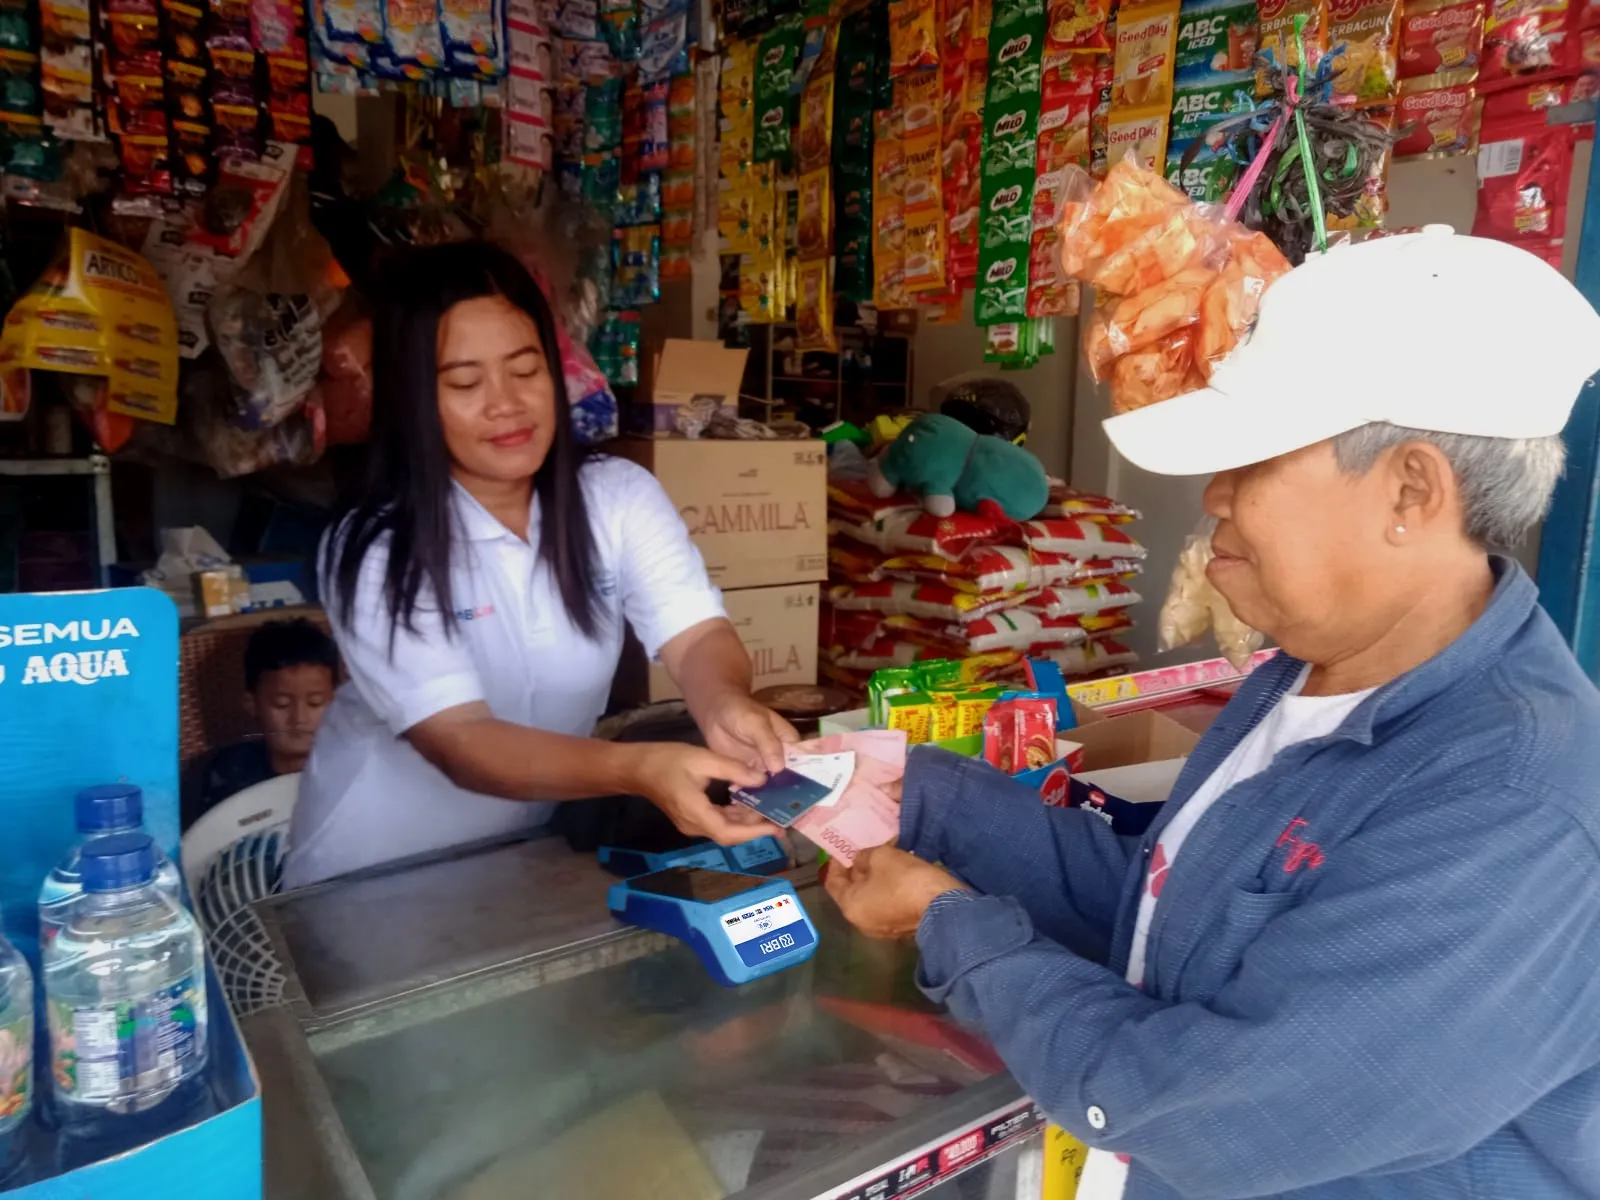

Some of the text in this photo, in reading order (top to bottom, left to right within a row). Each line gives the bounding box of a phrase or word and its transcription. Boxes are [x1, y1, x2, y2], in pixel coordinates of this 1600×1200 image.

[1179, 16, 1226, 40] ABC
[1001, 41, 1027, 59] MILO
[1187, 37, 1216, 50] ICED
[1172, 91, 1222, 115] ABC
[996, 116, 1023, 132] MILO
[1109, 128, 1138, 144] Good
[1139, 126, 1158, 142] Day
[1168, 167, 1213, 187] ABC
[994, 192, 1018, 207] MILO
[989, 264, 1013, 279] MILO
[21, 648, 129, 685] AQUA
[759, 938, 781, 955] BRI
[991, 1111, 1029, 1135] FILTER
